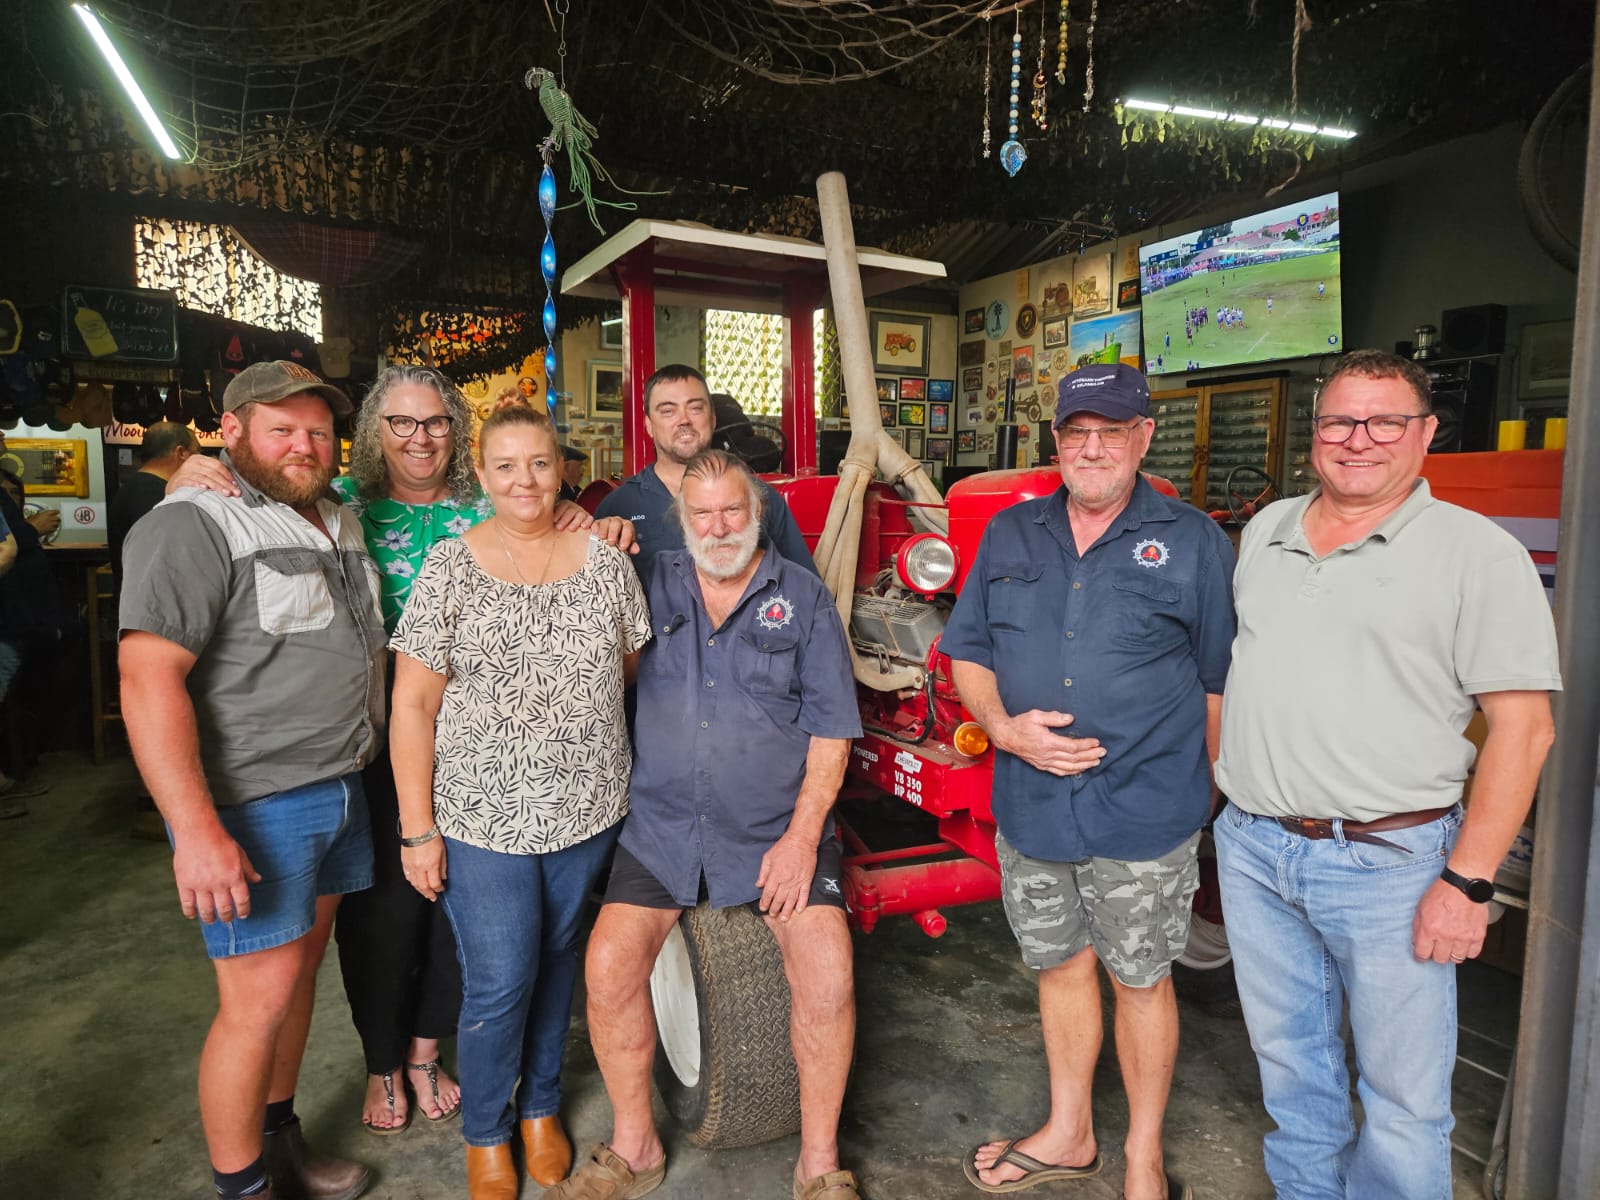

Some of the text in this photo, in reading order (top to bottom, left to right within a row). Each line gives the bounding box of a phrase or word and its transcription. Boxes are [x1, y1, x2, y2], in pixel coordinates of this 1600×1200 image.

[135, 301, 163, 320] Dry
[853, 746, 878, 762] POWERED
[862, 761, 869, 771] BY
[894, 770, 922, 792] V8 350
[894, 783, 922, 806] HP 400
